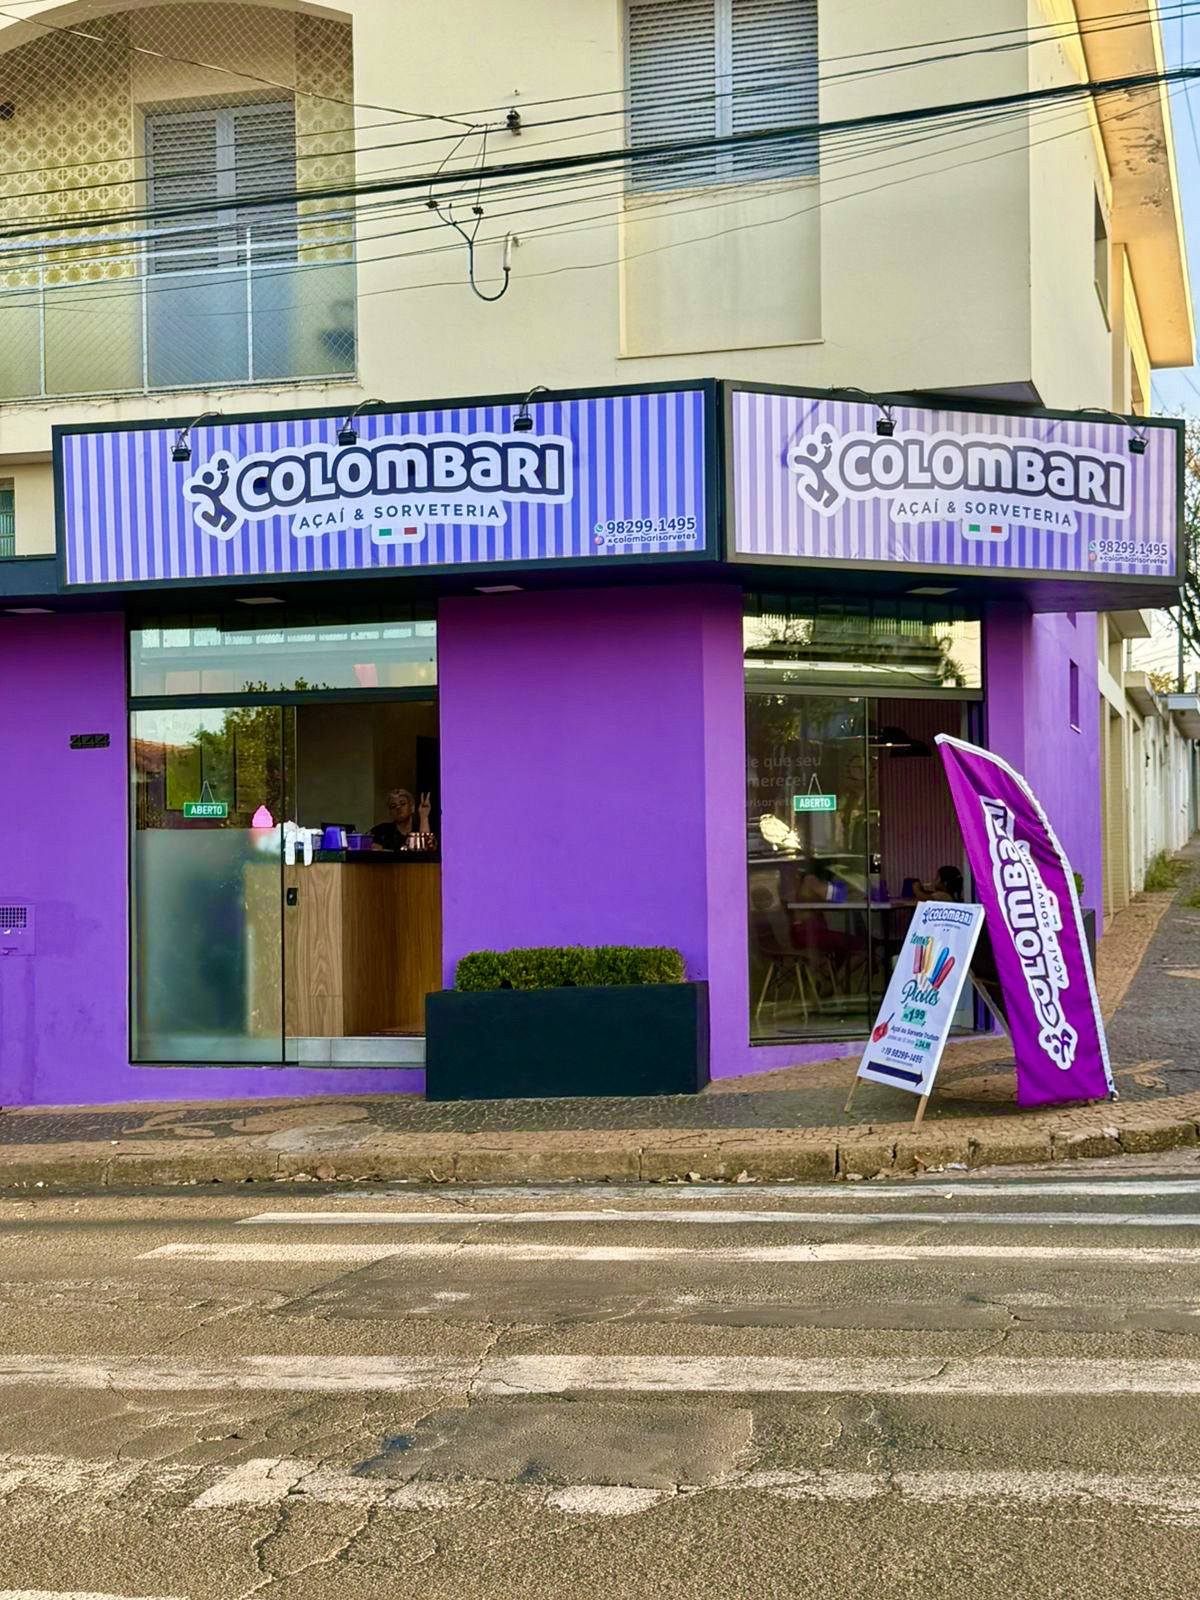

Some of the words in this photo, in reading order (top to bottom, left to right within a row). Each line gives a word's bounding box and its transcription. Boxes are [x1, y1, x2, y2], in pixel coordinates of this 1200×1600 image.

[299, 507, 345, 530] AÇAÍ
[354, 508, 365, 521] &
[374, 503, 500, 520] SORVETERIA
[896, 498, 939, 517] AÇAÍ
[946, 501, 957, 513] &
[964, 500, 1072, 527] SORVETERIA
[606, 517, 696, 535] 98299.1495
[1099, 540, 1168, 556] 98299.1495
[795, 756, 822, 767] seu
[190, 804, 223, 815] ABERTO
[799, 797, 831, 808] ABERTO
